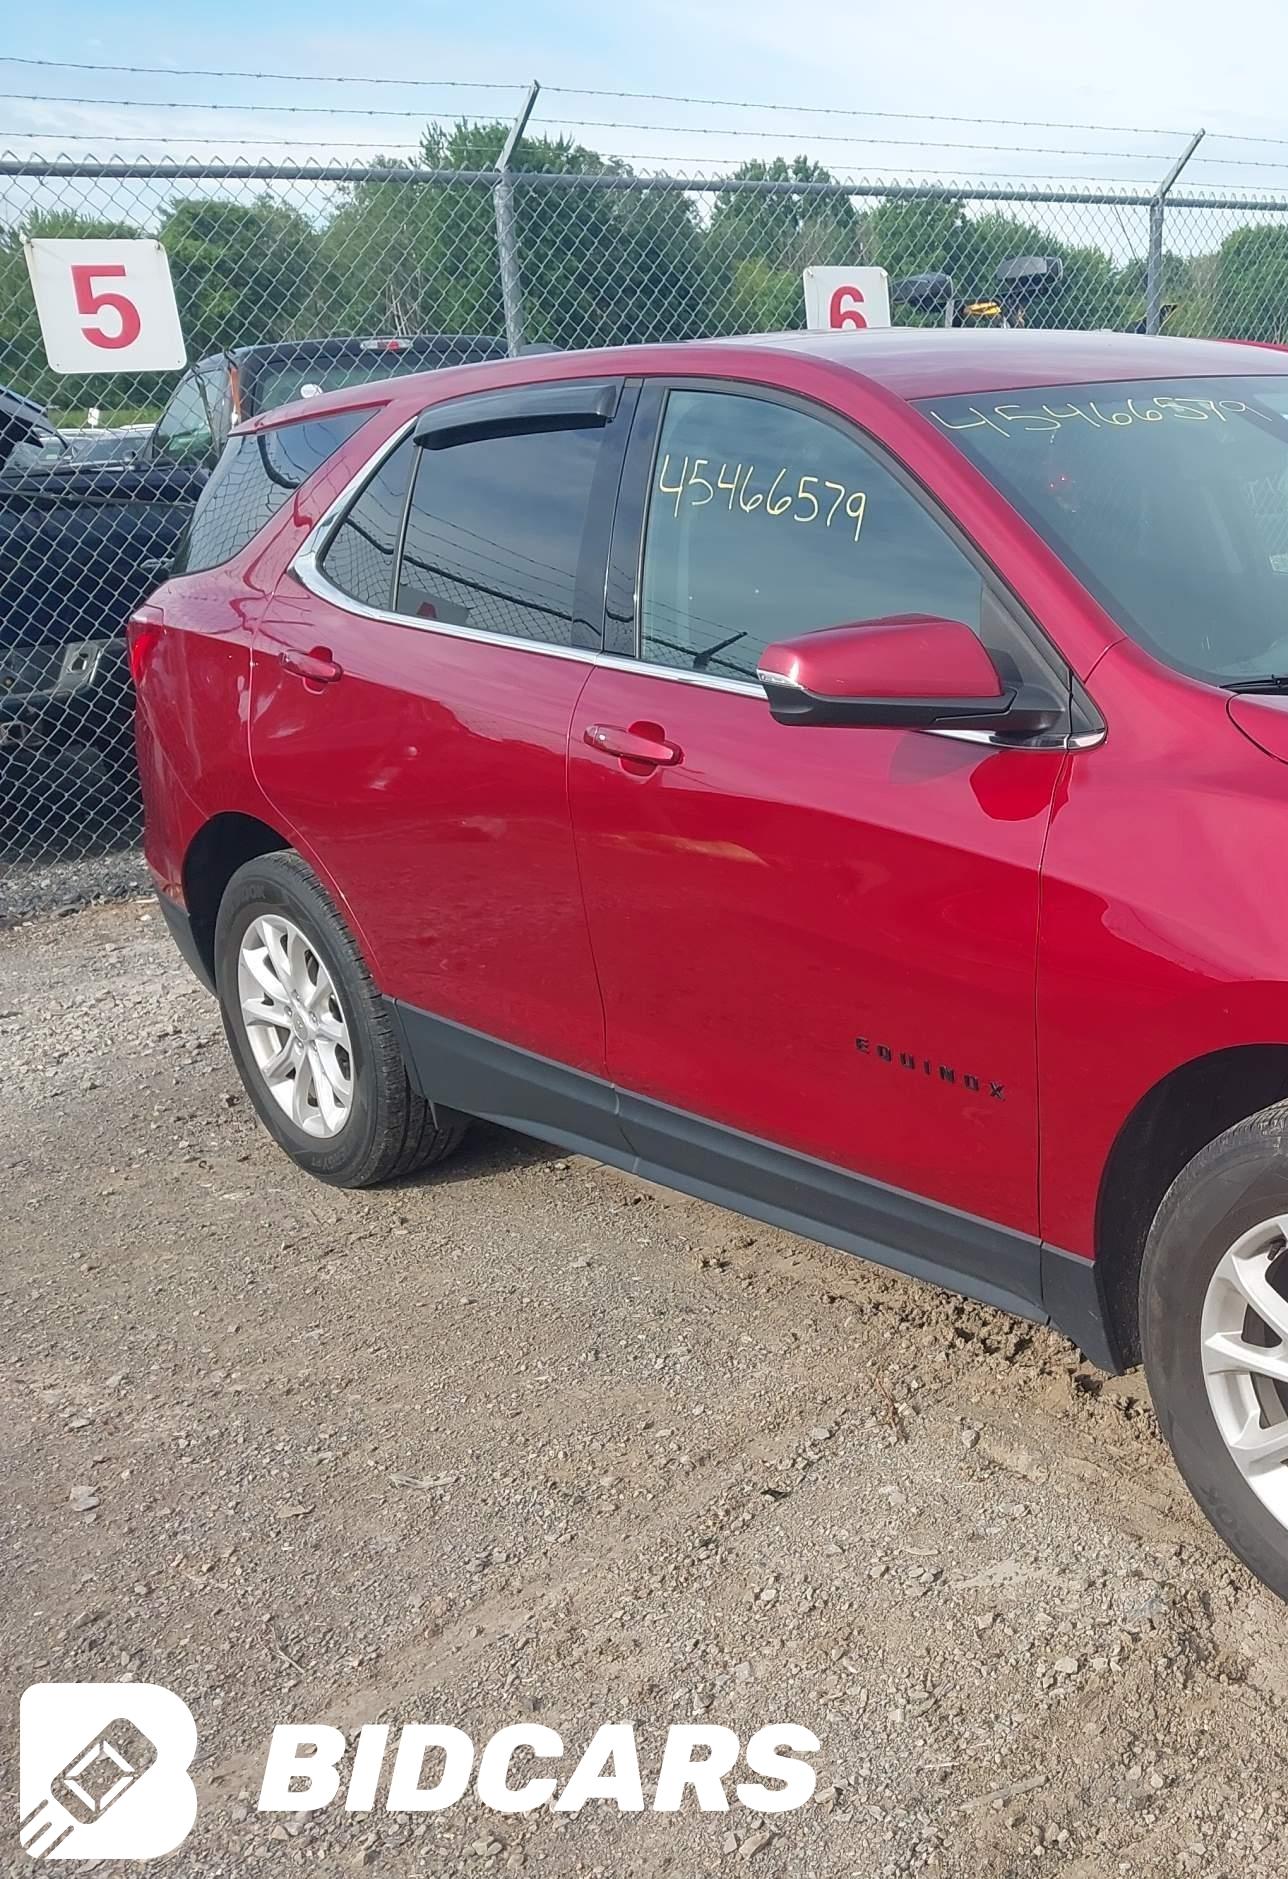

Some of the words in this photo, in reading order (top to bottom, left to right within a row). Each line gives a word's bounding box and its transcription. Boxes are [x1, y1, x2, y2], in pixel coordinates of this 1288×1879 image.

[72, 265, 141, 349] 5
[830, 286, 868, 329] 6
[930, 397, 1273, 438] 45466579
[659, 454, 867, 542] 45466579
[855, 1036, 1006, 1101] EQUINOX
